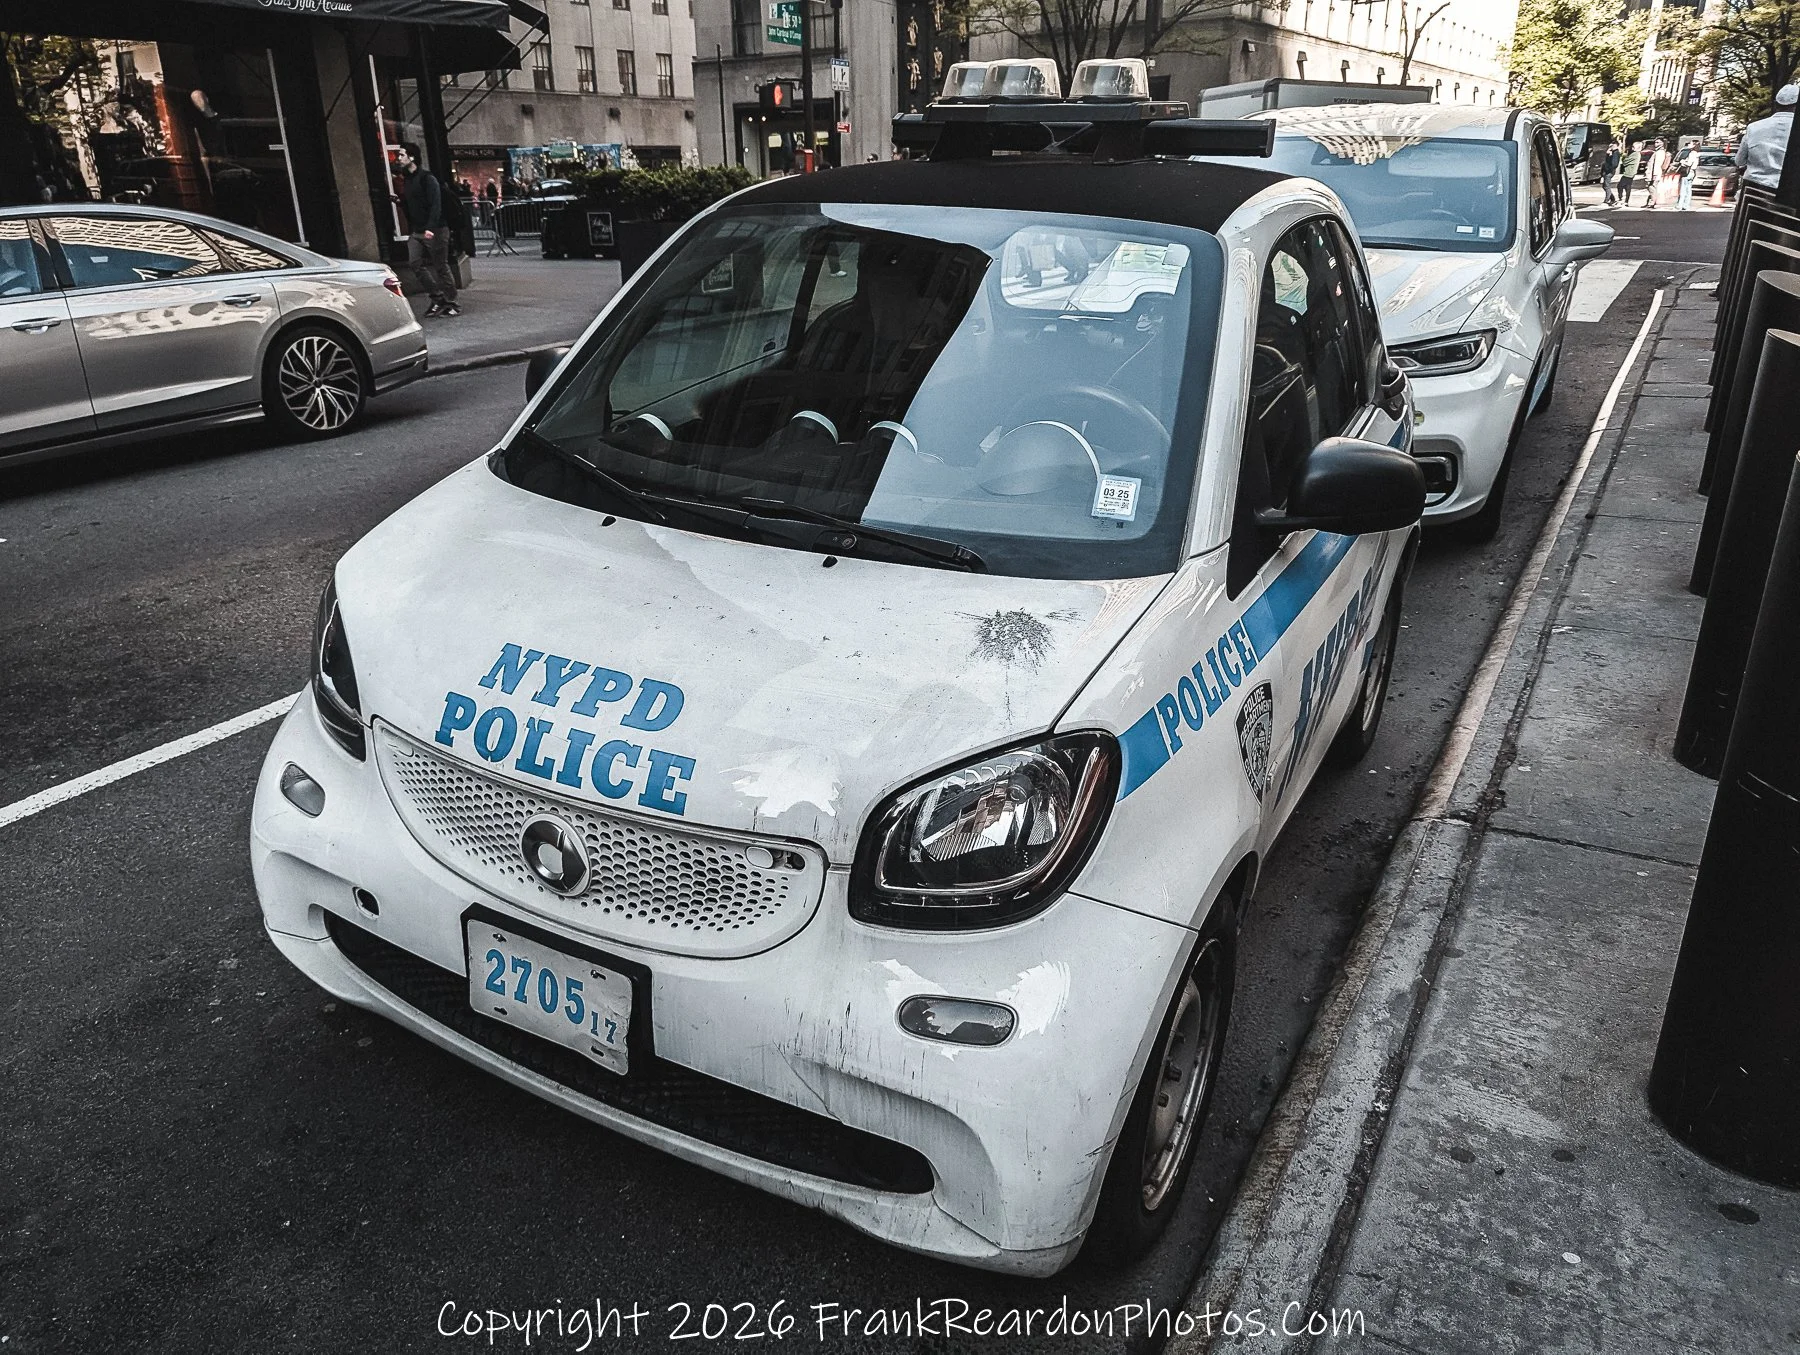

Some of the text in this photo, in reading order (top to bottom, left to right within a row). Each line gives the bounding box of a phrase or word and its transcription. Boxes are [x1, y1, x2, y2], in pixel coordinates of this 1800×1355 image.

[311, 0, 353, 13] Avenue
[1103, 488, 1115, 497] 03
[1117, 490, 1129, 499] 25
[478, 642, 685, 732] NYPD
[1158, 619, 1257, 755] POLICE
[1243, 686, 1266, 719] POLICE
[434, 691, 697, 816] POLICE
[1240, 699, 1272, 748] DEPARTMENT
[485, 948, 618, 1045] 2705 17
